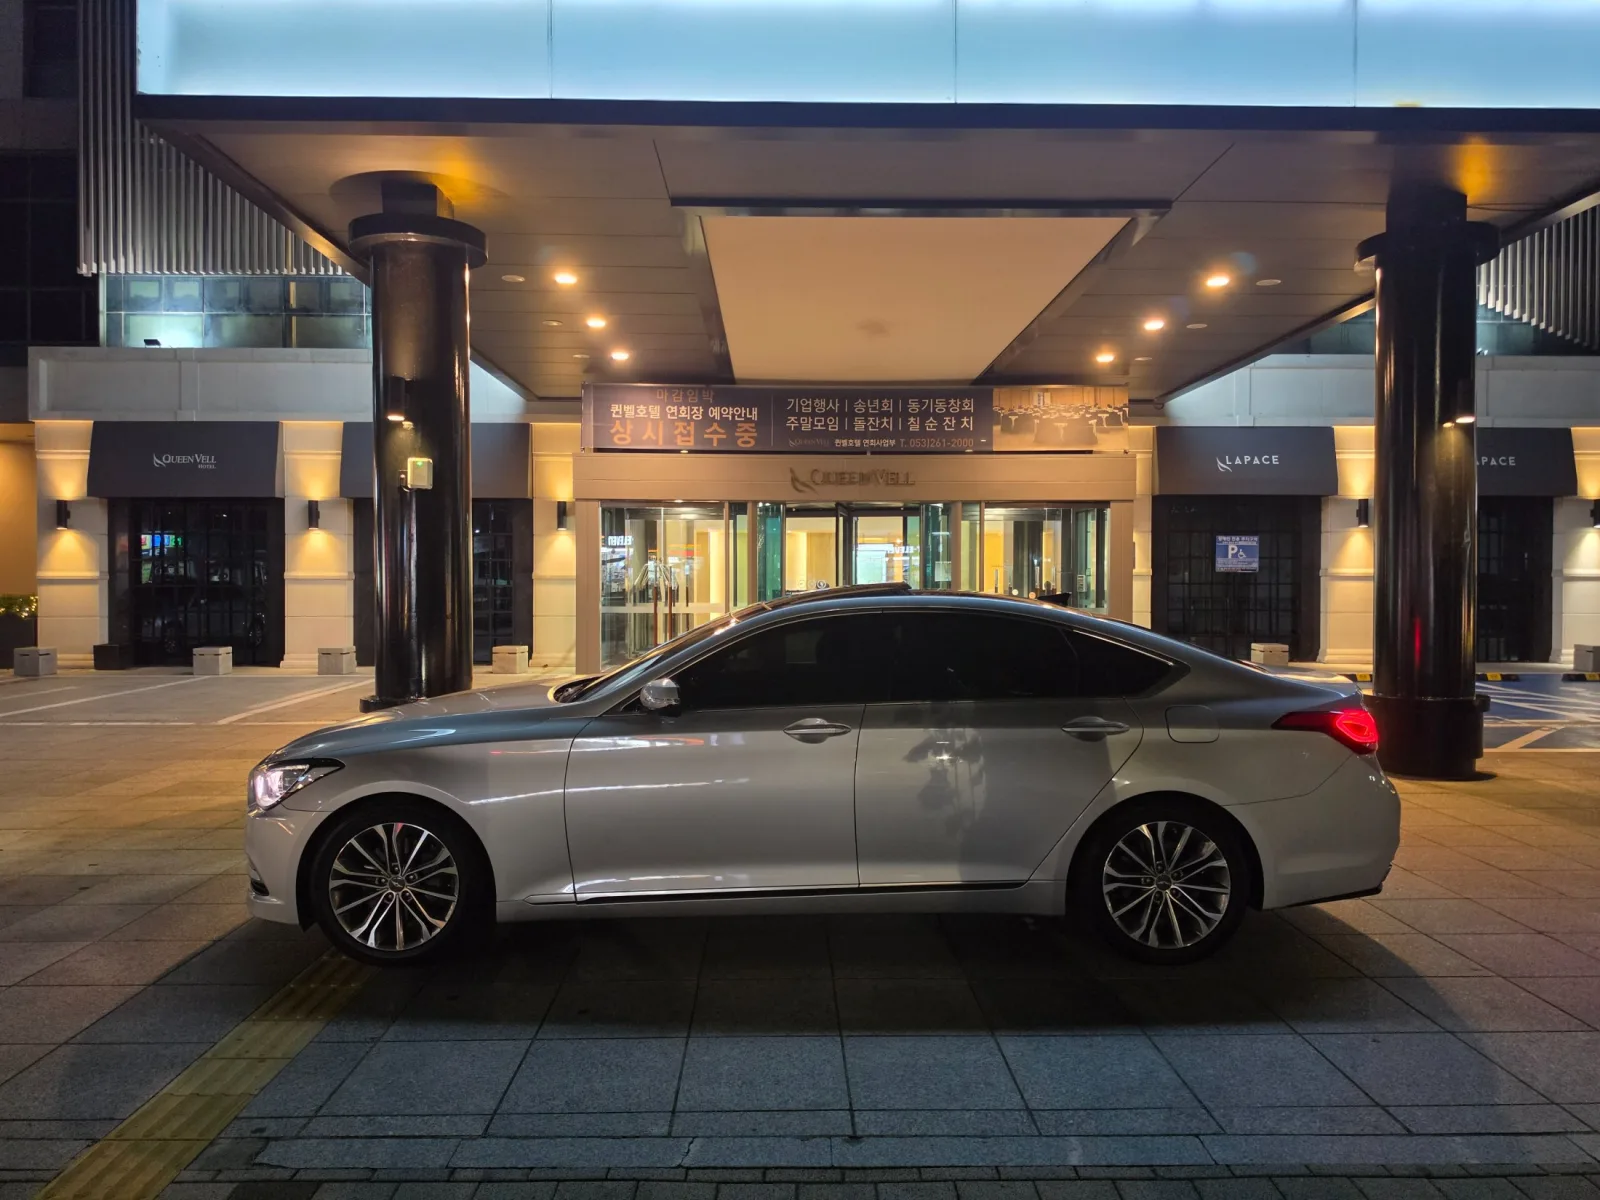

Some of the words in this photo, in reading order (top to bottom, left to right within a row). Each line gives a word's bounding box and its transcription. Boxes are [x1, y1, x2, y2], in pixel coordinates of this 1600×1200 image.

[610, 404, 661, 419] 퀸벨호텔
[665, 405, 704, 420] 연회장
[708, 406, 758, 421] 예약안내
[787, 398, 840, 413] 기업행사
[853, 398, 893, 413] 송년회
[907, 398, 974, 413] 동기동창회
[786, 416, 839, 431] 주말모임
[853, 416, 893, 431] 돌잔치
[834, 439, 861, 448] 퀸벨호텔
[862, 439, 896, 448] 연회사업부
[909, 438, 974, 448] 053)261-2000
[1225, 455, 1280, 465] LAPACE
[1228, 545, 1238, 558] P
